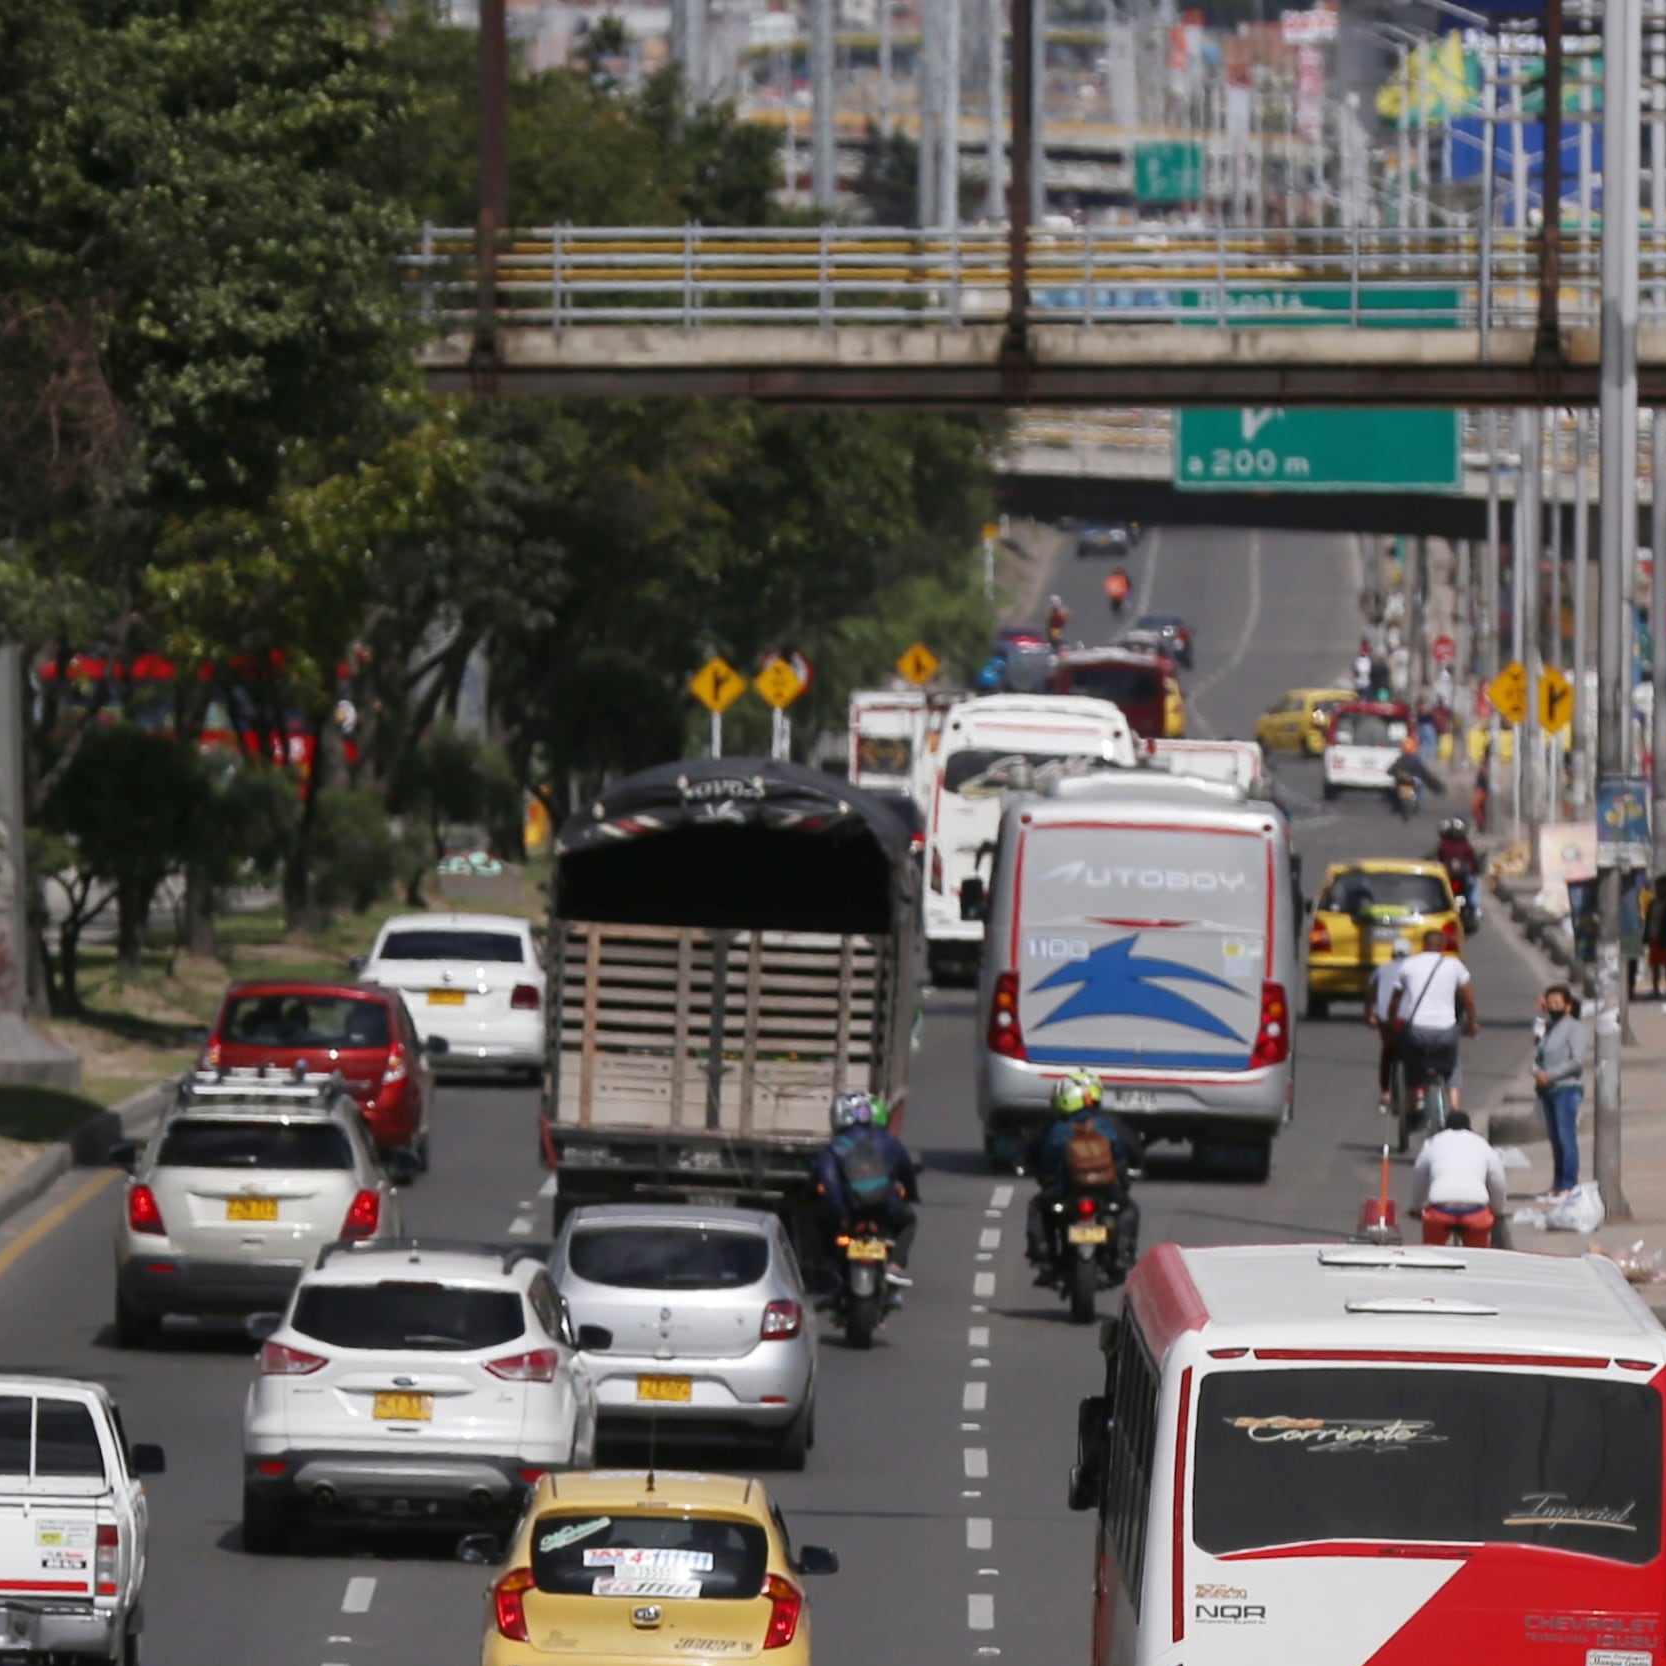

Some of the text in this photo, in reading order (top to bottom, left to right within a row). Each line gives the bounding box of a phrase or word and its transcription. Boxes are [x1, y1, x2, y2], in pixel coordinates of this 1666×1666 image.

[1211, 448, 1277, 475] 200
[1284, 454, 1310, 475] m
[1248, 1415, 1423, 1443] Corriente
[1521, 1493, 1637, 1530] Imperial
[1195, 1604, 1267, 1619] NQR
[1524, 1615, 1659, 1633] CHEVROLET
[1596, 1633, 1659, 1649] ISUZU
